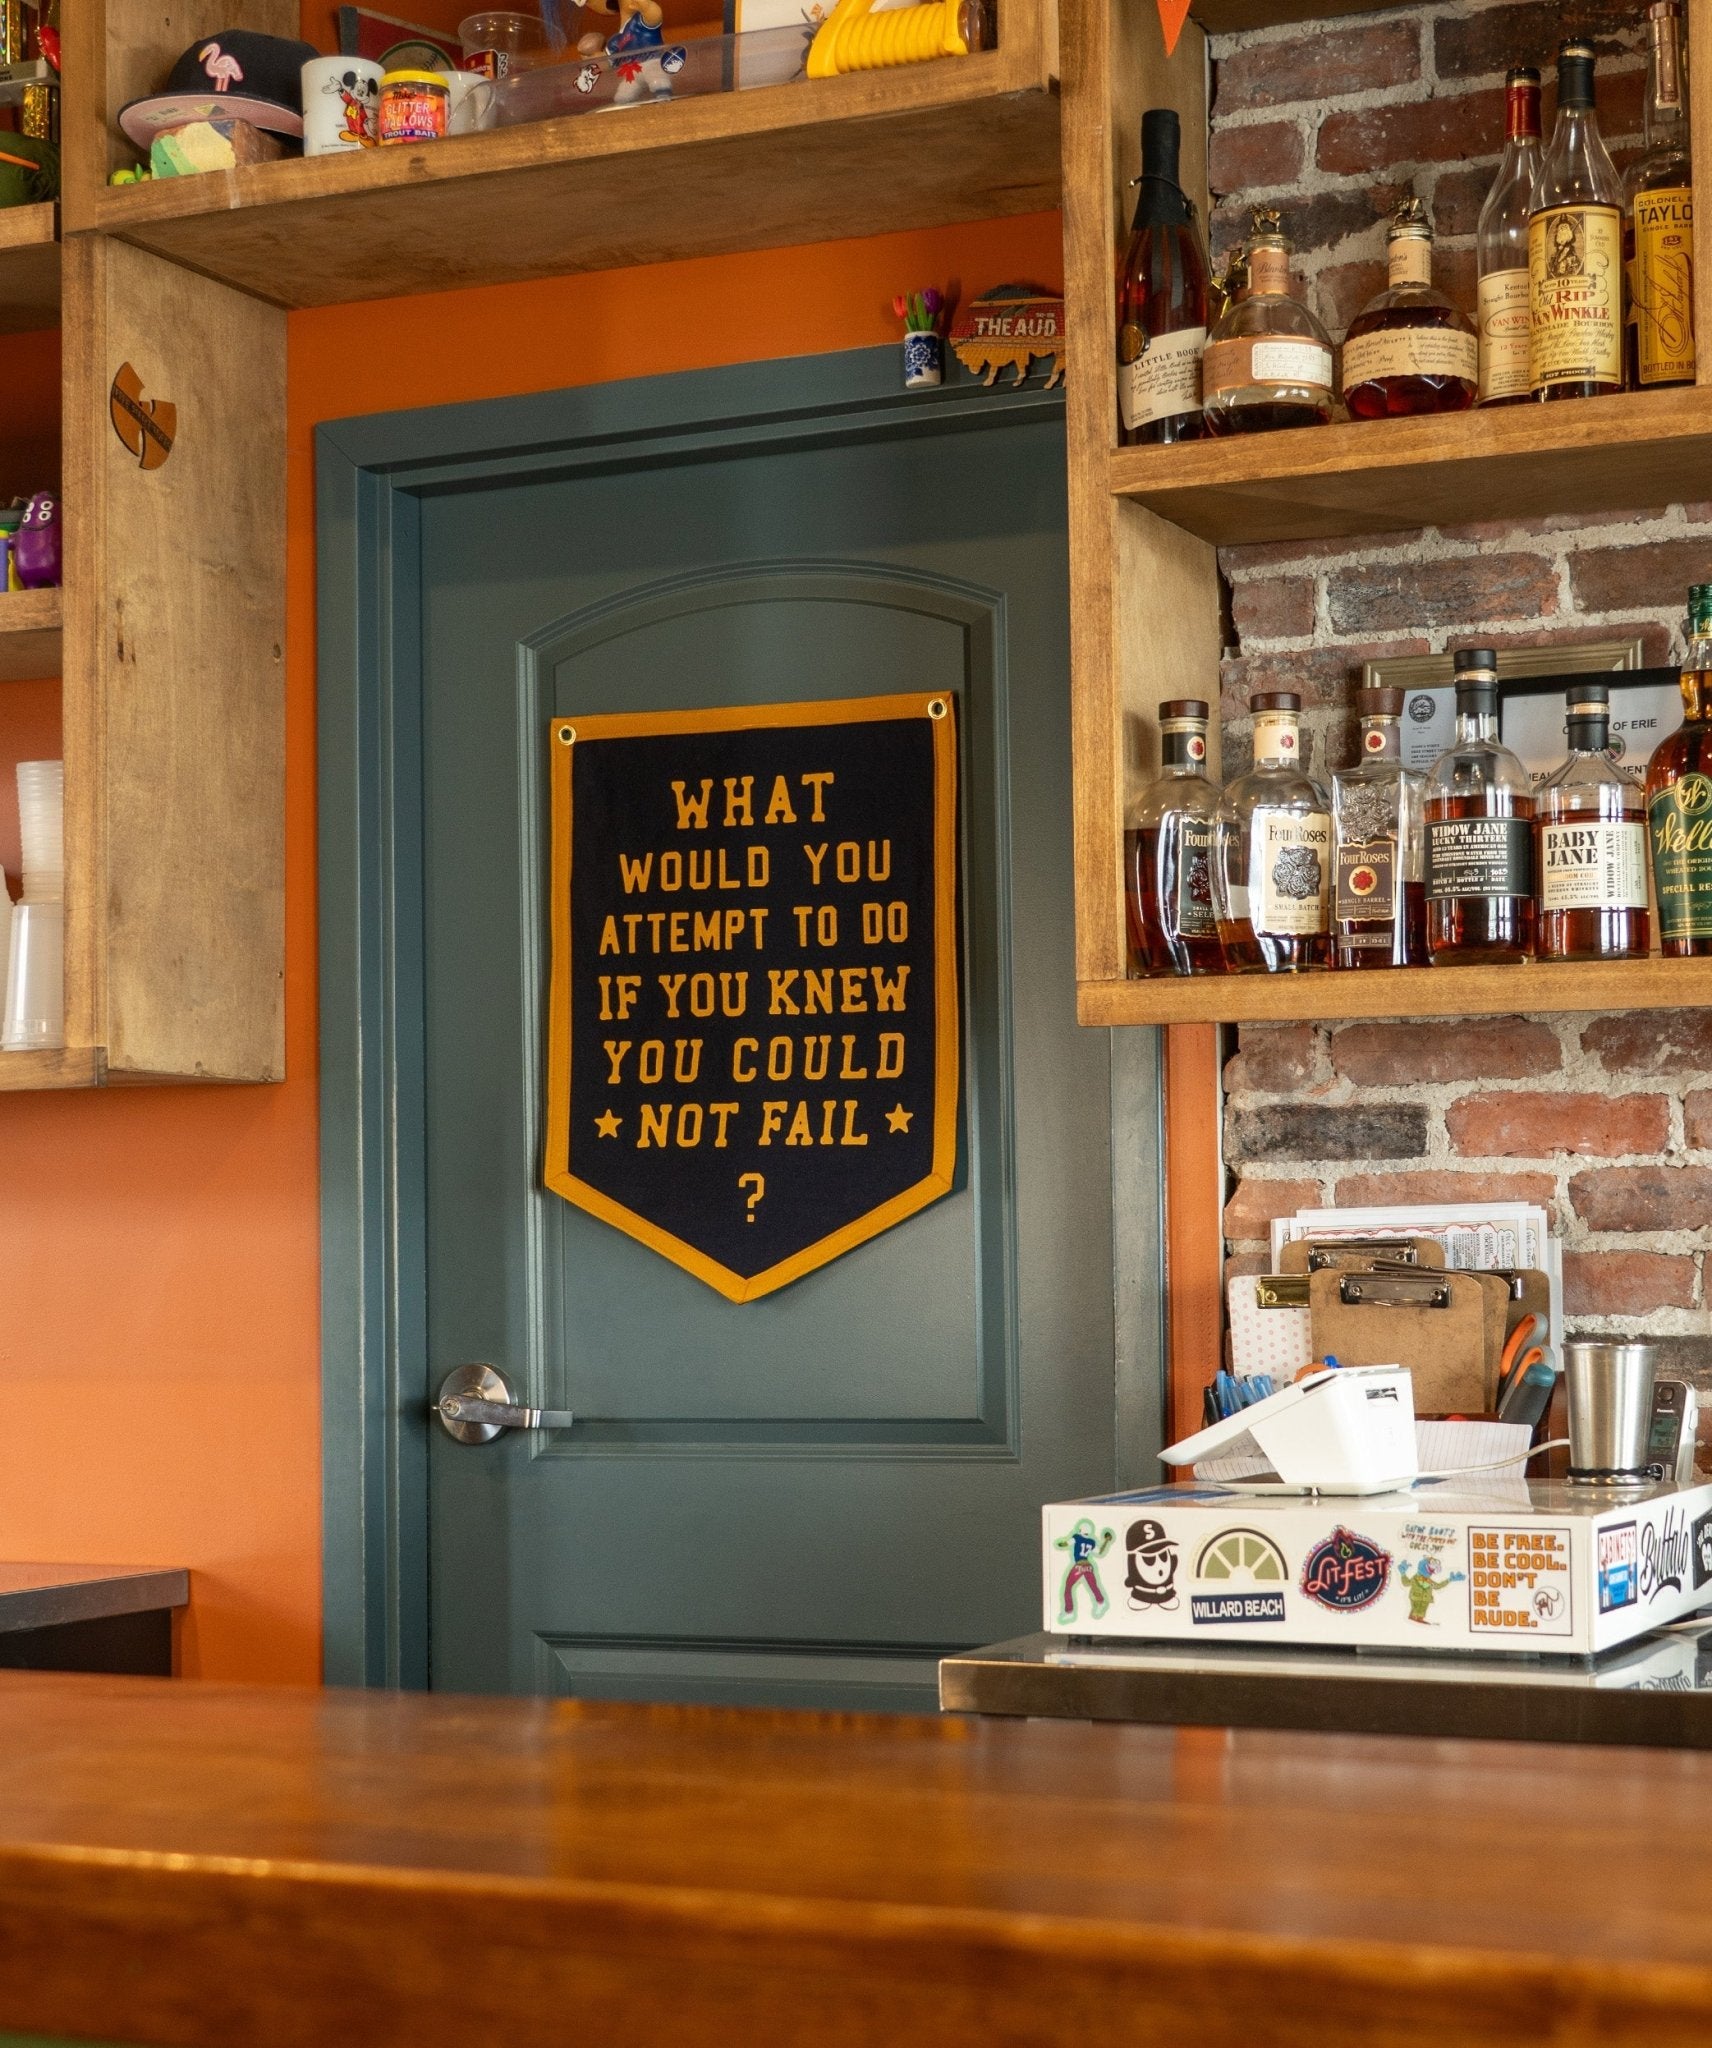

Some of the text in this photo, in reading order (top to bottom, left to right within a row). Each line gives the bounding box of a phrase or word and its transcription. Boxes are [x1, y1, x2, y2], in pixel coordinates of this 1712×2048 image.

[386, 102, 430, 115] GLITTER
[384, 116, 433, 128] MALLOWS
[384, 130, 437, 139] TROUT BAIT
[1639, 196, 1684, 208] COLONEL
[1639, 204, 1694, 225] TAYLO
[1557, 278, 1570, 288] 10
[975, 317, 1056, 337] THE AUD
[1492, 316, 1509, 327] VAN
[1134, 347, 1200, 371] LITTLE BOOK
[1643, 361, 1674, 374] BOTTLED
[1676, 361, 1684, 370] IN
[1613, 719, 1657, 731] OF ERIE
[671, 772, 834, 829] WHAT
[1432, 823, 1508, 837] WIDOW JANE
[1654, 812, 1712, 855] Well
[1432, 835, 1507, 845] LUCKY THIRTEEN
[1547, 830, 1599, 849] BABY
[619, 840, 891, 893] WOULD YOU
[1340, 851, 1389, 865] Four Roses
[1547, 848, 1598, 867] JANE
[1605, 830, 1615, 898] WIDOW JANE
[1662, 884, 1695, 894] SPECIAL
[599, 902, 908, 955] ATTEMPT TO DO
[599, 966, 911, 1020] IF YOU KNEW
[603, 1033, 905, 1084] YOU COULD
[637, 1100, 869, 1149] NOT FAIL
[738, 1172, 764, 1222] ?
[1143, 1523, 1156, 1540] S
[1080, 1543, 1092, 1557] 17
[1472, 1533, 1564, 1551] BE FREE.
[1473, 1552, 1567, 1570] BE COOL.
[1473, 1571, 1537, 1588] DON'T
[1473, 1590, 1500, 1606] BE
[1192, 1598, 1284, 1618] WILLARD BEACH
[1473, 1609, 1538, 1627] RUDE.
